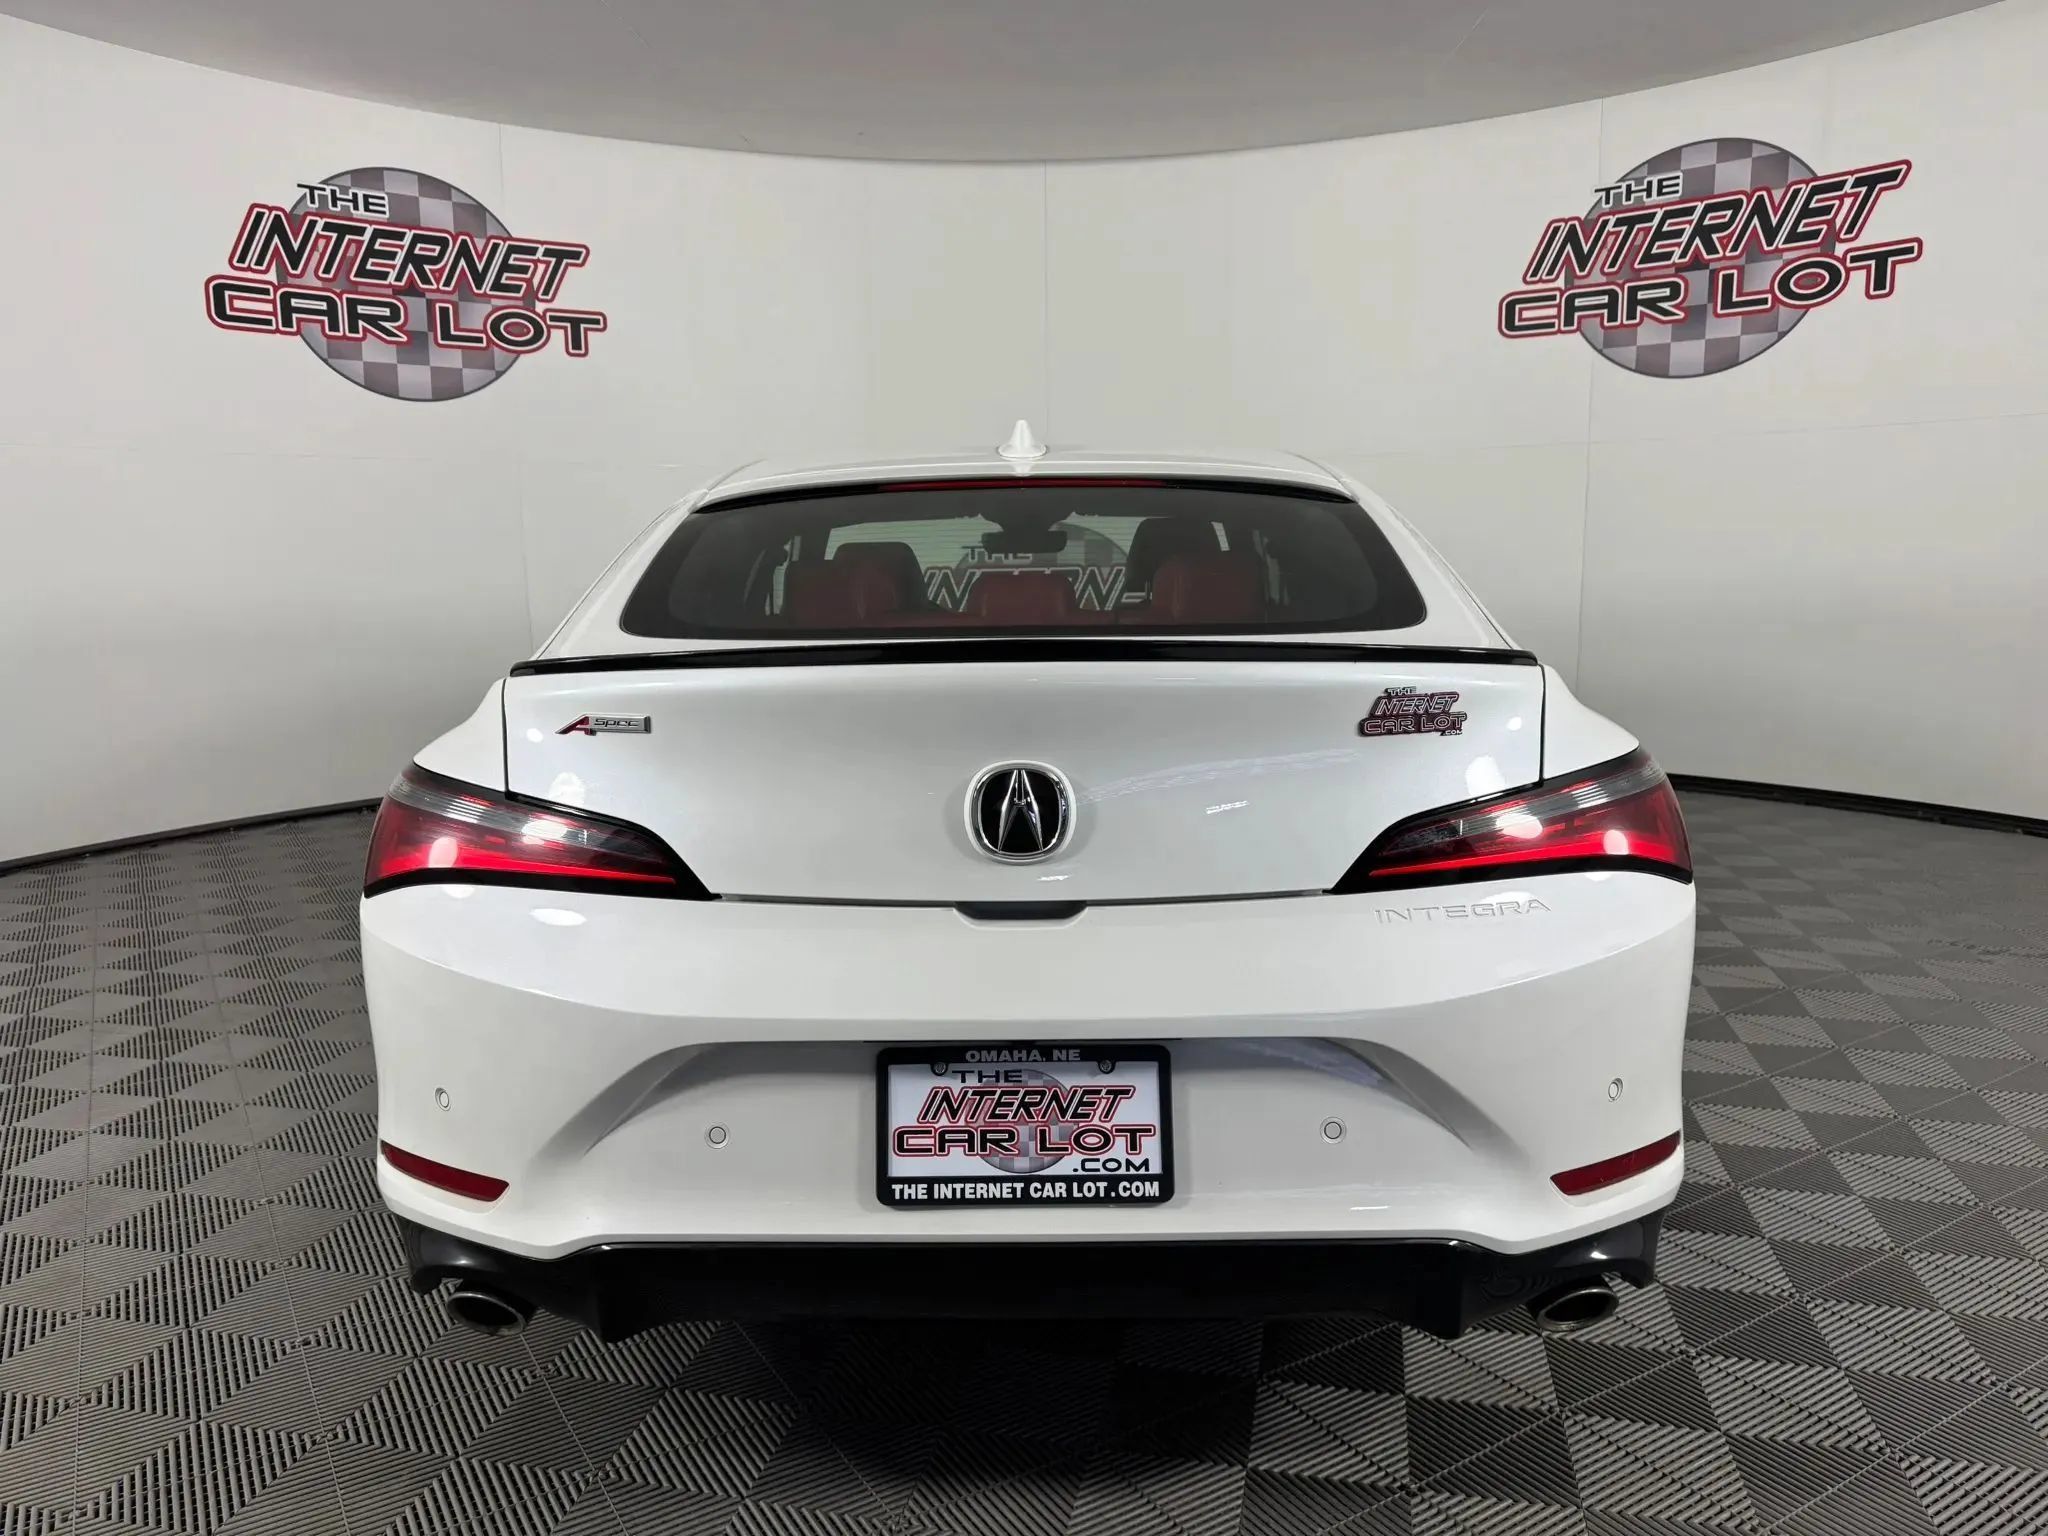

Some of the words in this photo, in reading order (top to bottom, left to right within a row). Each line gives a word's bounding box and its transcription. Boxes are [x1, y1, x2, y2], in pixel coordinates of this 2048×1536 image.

[297, 183, 389, 216] THE
[1594, 173, 1683, 206] THE
[1523, 159, 1912, 284] INTERNET
[229, 203, 590, 303] INTERNET
[1499, 274, 1688, 337] CAR
[1713, 237, 1923, 317] LOT
[205, 275, 409, 345] CAR
[434, 299, 607, 357] LOT
[1374, 693, 1459, 716] INTERNET
[1386, 687, 1417, 696] THE
[1363, 717, 1416, 735] CAR
[1420, 713, 1467, 731] LOT
[1375, 898, 1551, 923] INTEGRA
[1053, 1050, 1081, 1062] NE
[952, 1070, 1022, 1083] THE
[917, 1085, 1136, 1123] INTERNET
[893, 1126, 1020, 1156] CAR
[1035, 1124, 1156, 1156] LOT
[1073, 1158, 1150, 1173] .COM
[892, 1184, 928, 1199] THE
[934, 1183, 1024, 1199] INTERNET
[1029, 1182, 1067, 1198] CAR
